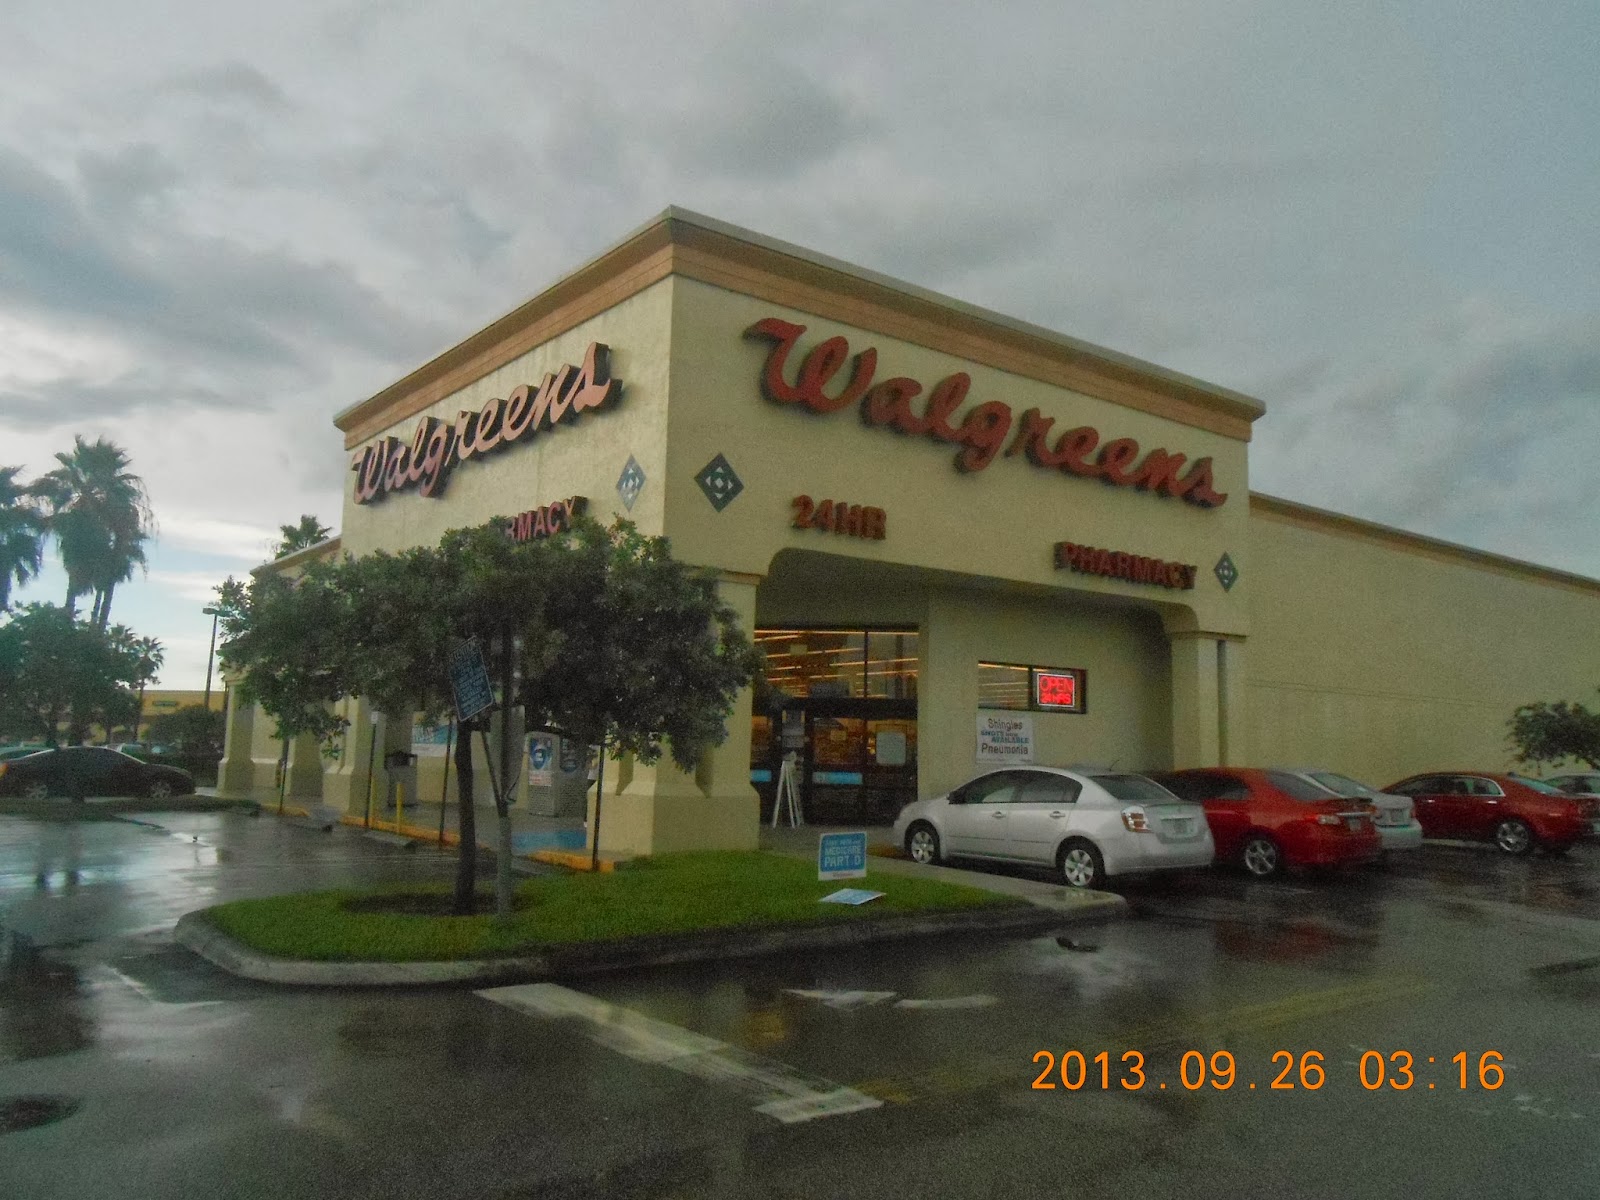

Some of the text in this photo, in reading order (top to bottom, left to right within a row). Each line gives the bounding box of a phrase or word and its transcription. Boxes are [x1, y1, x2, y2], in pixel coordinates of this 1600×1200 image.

[743, 317, 1228, 506] Walgreens
[352, 342, 623, 504] Walgreens
[1053, 542, 1198, 590] PHARMACY
[1039, 676, 1073, 693] OPEN
[988, 718, 1023, 731] Shingles
[991, 736, 1030, 744] AVAILABLE
[981, 742, 1029, 755] Pneumonia
[824, 845, 862, 856] MEDICARE
[824, 855, 862, 867] PART D
